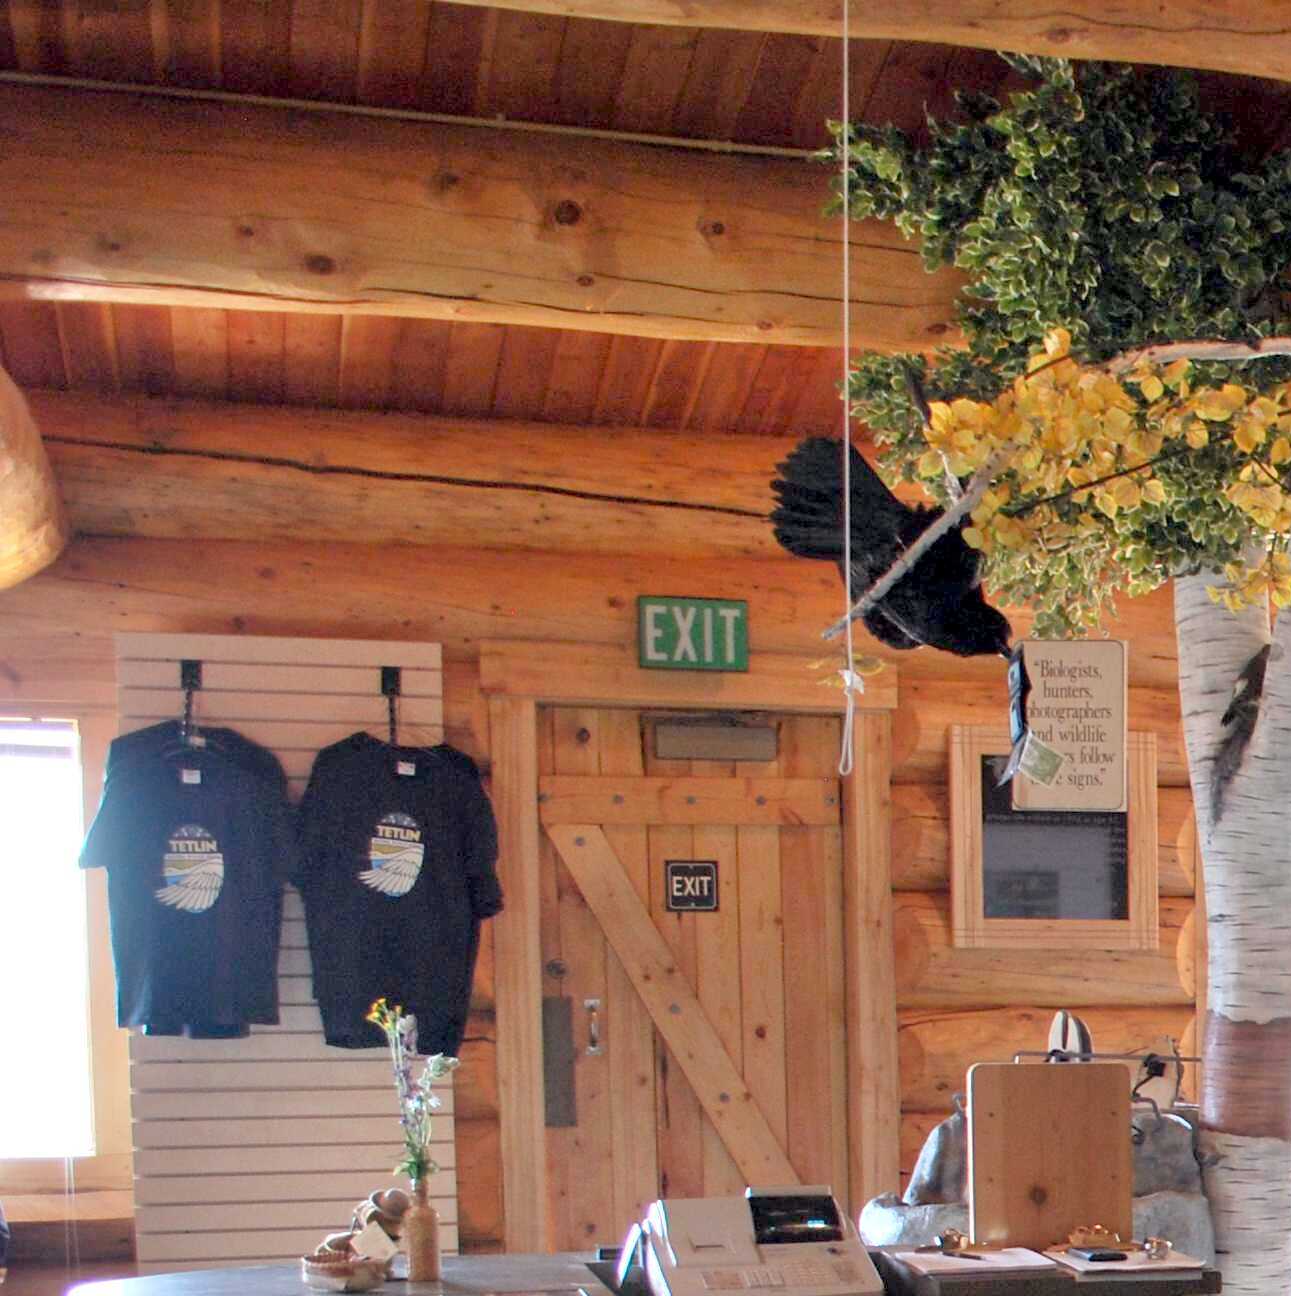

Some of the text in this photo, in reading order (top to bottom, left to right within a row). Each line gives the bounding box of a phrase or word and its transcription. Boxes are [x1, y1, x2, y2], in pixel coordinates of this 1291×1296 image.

[645, 604, 741, 664] EXIT
[1043, 682, 1094, 699] hunters,
[1032, 725, 1107, 743] nd wildlife
[1079, 747, 1116, 764] follow
[376, 825, 422, 842] TETLIN
[168, 840, 218, 853] TETLIN
[672, 875, 712, 896] EXIT
